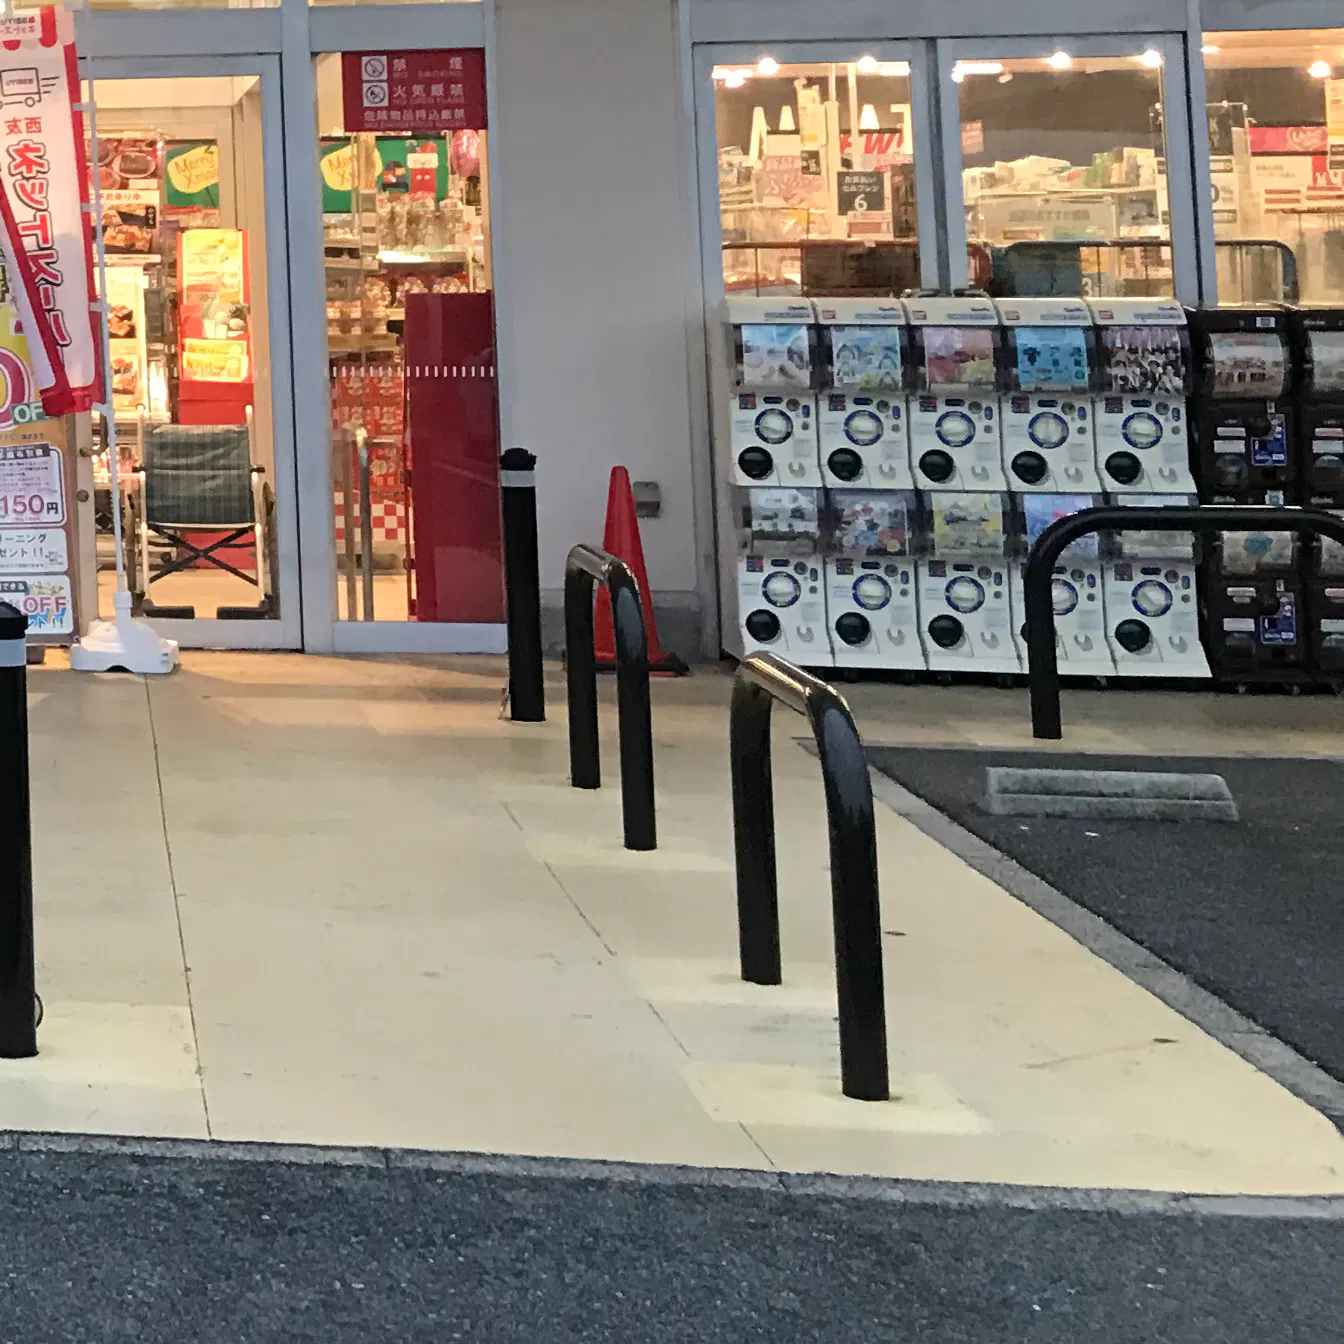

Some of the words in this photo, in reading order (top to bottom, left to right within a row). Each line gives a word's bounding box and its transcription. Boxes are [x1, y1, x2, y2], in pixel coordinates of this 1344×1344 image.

[854, 194, 868, 212] 6
[14, 403, 43, 423] OF
[0, 494, 58, 516] 150円
